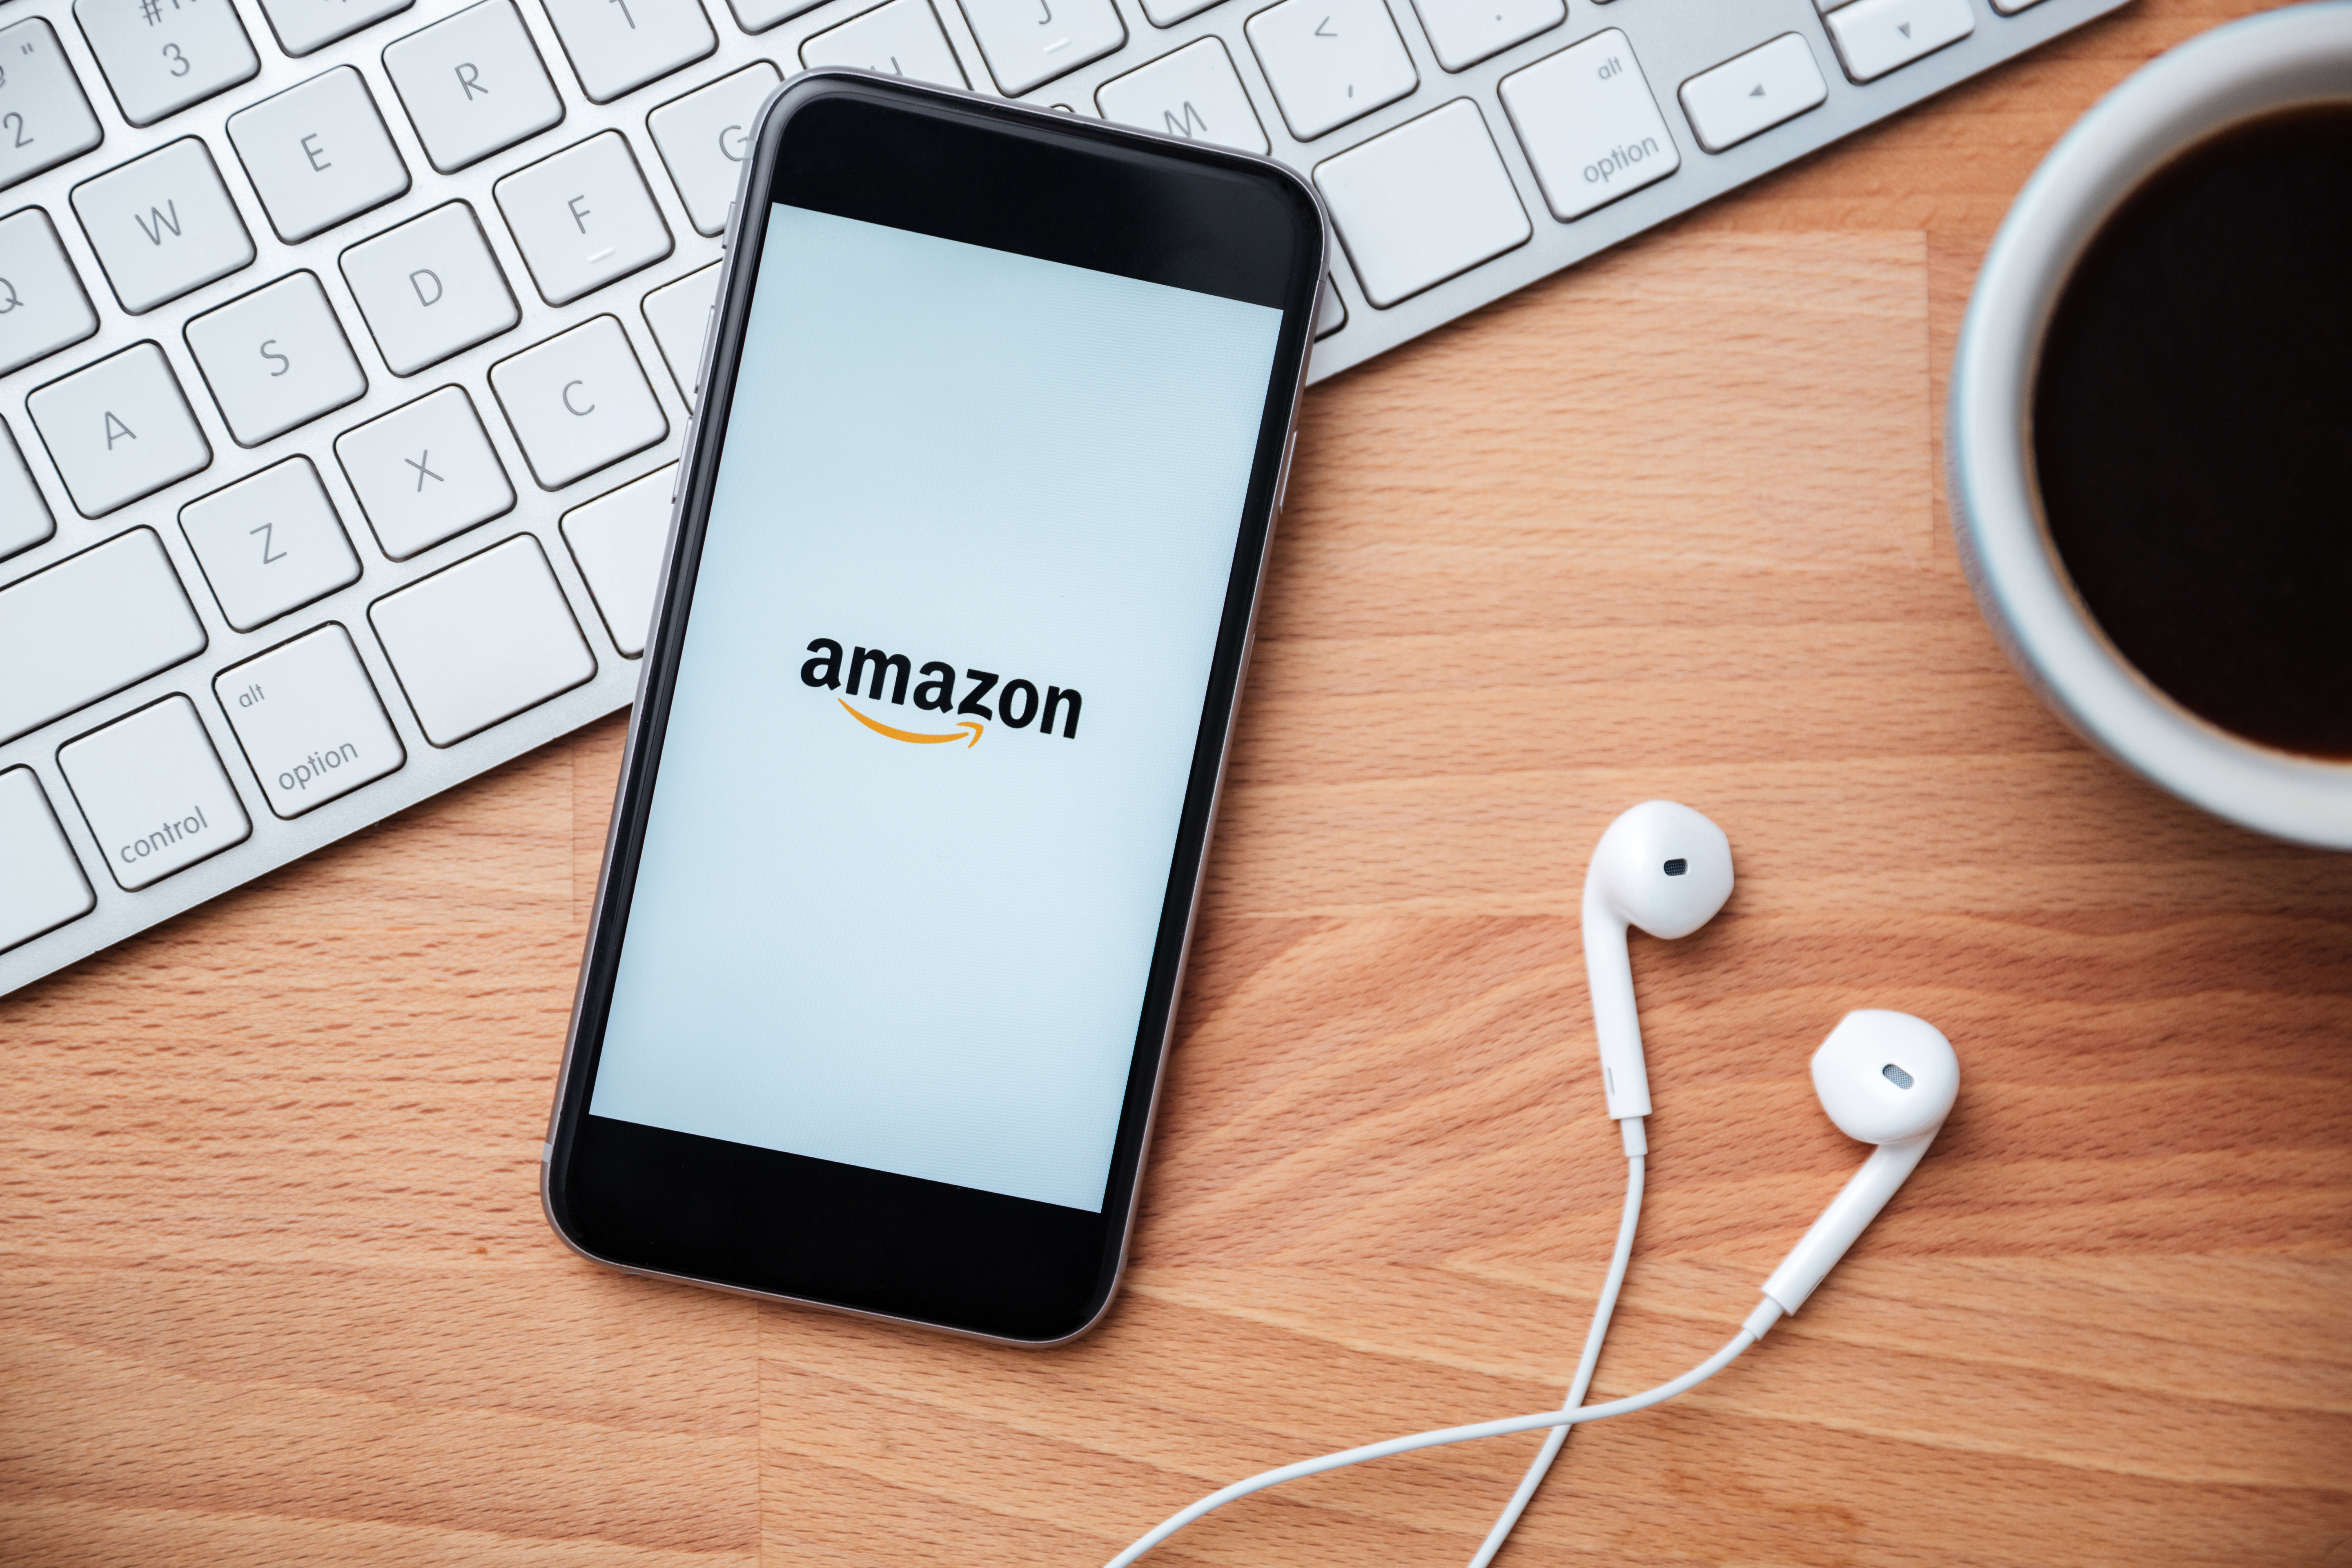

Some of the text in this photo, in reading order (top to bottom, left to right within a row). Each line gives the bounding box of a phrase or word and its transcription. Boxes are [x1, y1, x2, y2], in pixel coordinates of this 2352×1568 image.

[163, 43, 190, 77] 3
[1598, 56, 1623, 79] alt
[455, 63, 488, 100] R
[3, 112, 34, 148] 2
[1164, 100, 1207, 138] M
[301, 133, 331, 172] E
[719, 125, 749, 161] G
[1584, 137, 1659, 183] option
[135, 199, 181, 245] W
[568, 195, 590, 234] F
[409, 269, 442, 307] D
[260, 340, 289, 376] S
[563, 380, 595, 416] C
[105, 411, 136, 450] A
[405, 450, 444, 492] X
[250, 523, 287, 564] Z
[239, 684, 265, 708] alt
[800, 638, 1082, 739] amazon
[278, 743, 358, 790] option
[121, 805, 207, 863] control
